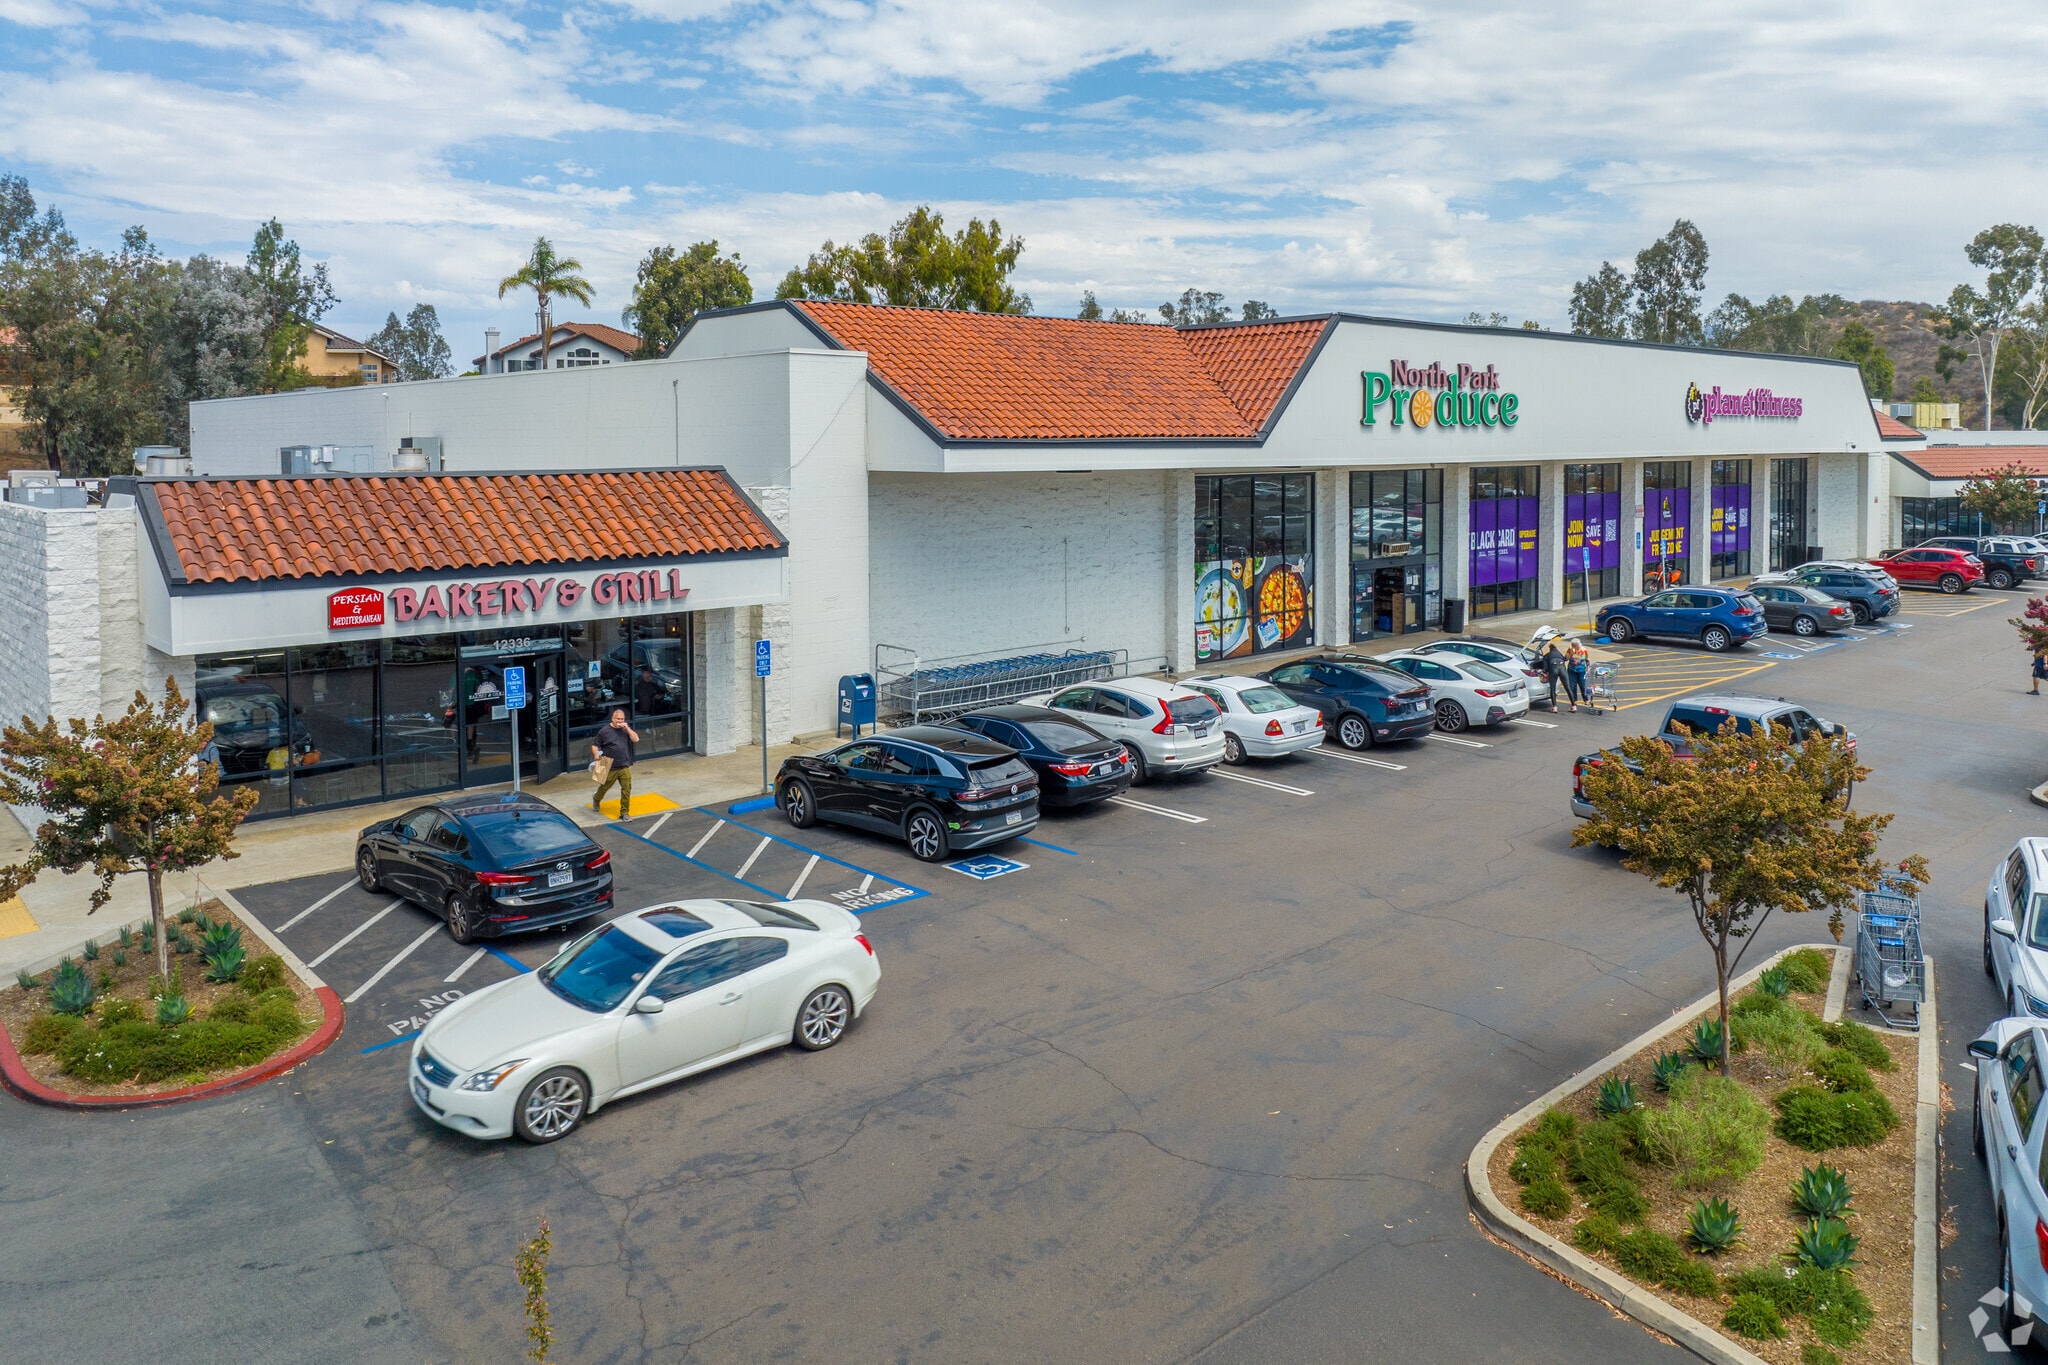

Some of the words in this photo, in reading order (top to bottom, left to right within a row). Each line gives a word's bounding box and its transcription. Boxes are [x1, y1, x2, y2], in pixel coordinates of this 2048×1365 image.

[1390, 359, 1448, 387] North
[1457, 363, 1500, 389] Park
[1360, 371, 1519, 427] Produce
[1725, 512, 1737, 523] SAVE
[1568, 519, 1583, 533] JOIN
[1585, 525, 1601, 538] SAVE
[1470, 530, 1495, 550] BLACK
[1567, 534, 1583, 548] NOW
[1649, 527, 1685, 543] JUGEMNT
[333, 593, 381, 605] PERSIAN
[387, 577, 556, 622] BAKERY
[556, 578, 587, 608] &
[592, 568, 692, 605] GRILL
[352, 604, 362, 614] &
[333, 613, 382, 626] MEDITERRANEAN
[493, 637, 531, 651] 12336
[592, 663, 598, 671] A
[830, 888, 867, 900] NO
[419, 989, 467, 1010] NO
